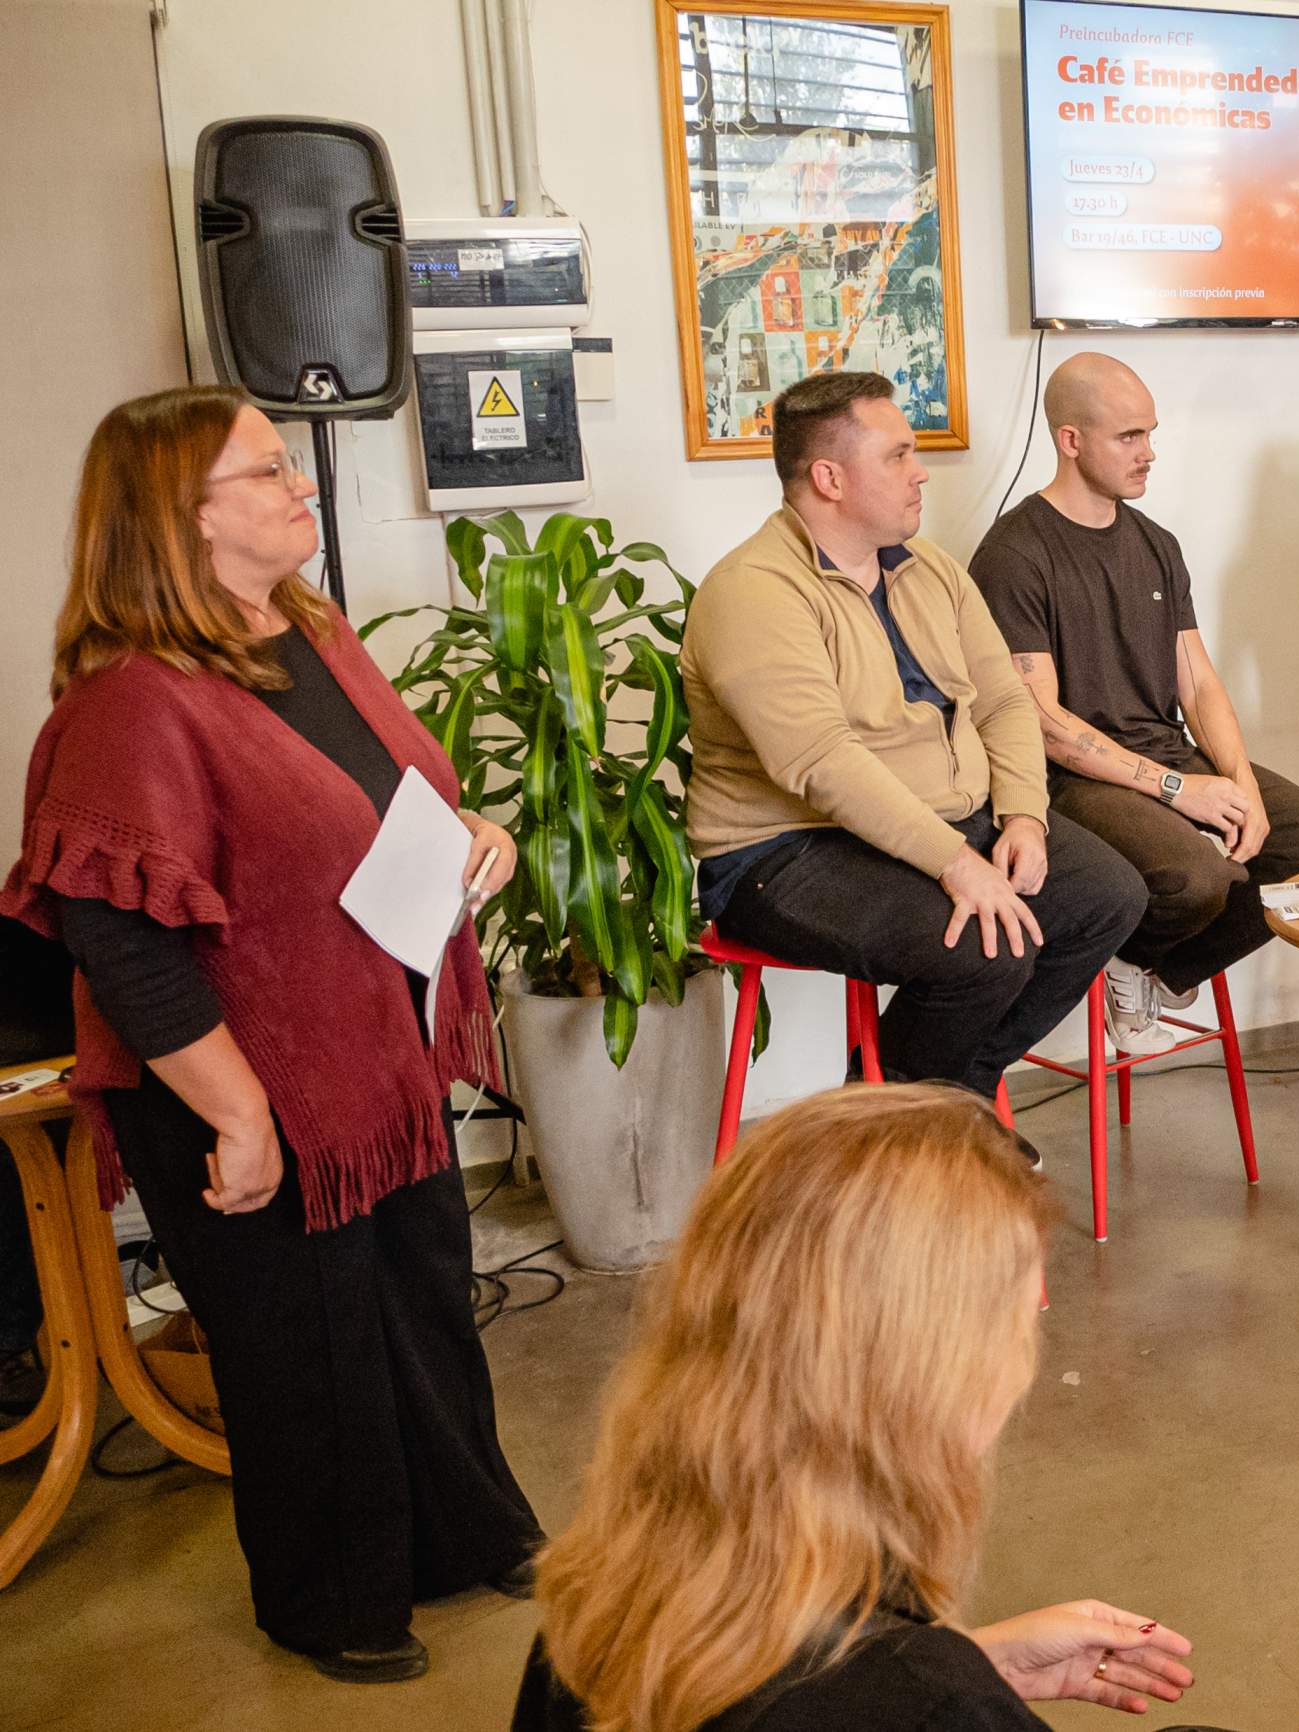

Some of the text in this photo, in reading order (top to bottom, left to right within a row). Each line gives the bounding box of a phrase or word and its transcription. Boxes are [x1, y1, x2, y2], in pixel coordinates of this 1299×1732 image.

[1057, 55, 1126, 86] Café
[1058, 95, 1271, 129] en Económicas
[1069, 159, 1111, 176] Jueves
